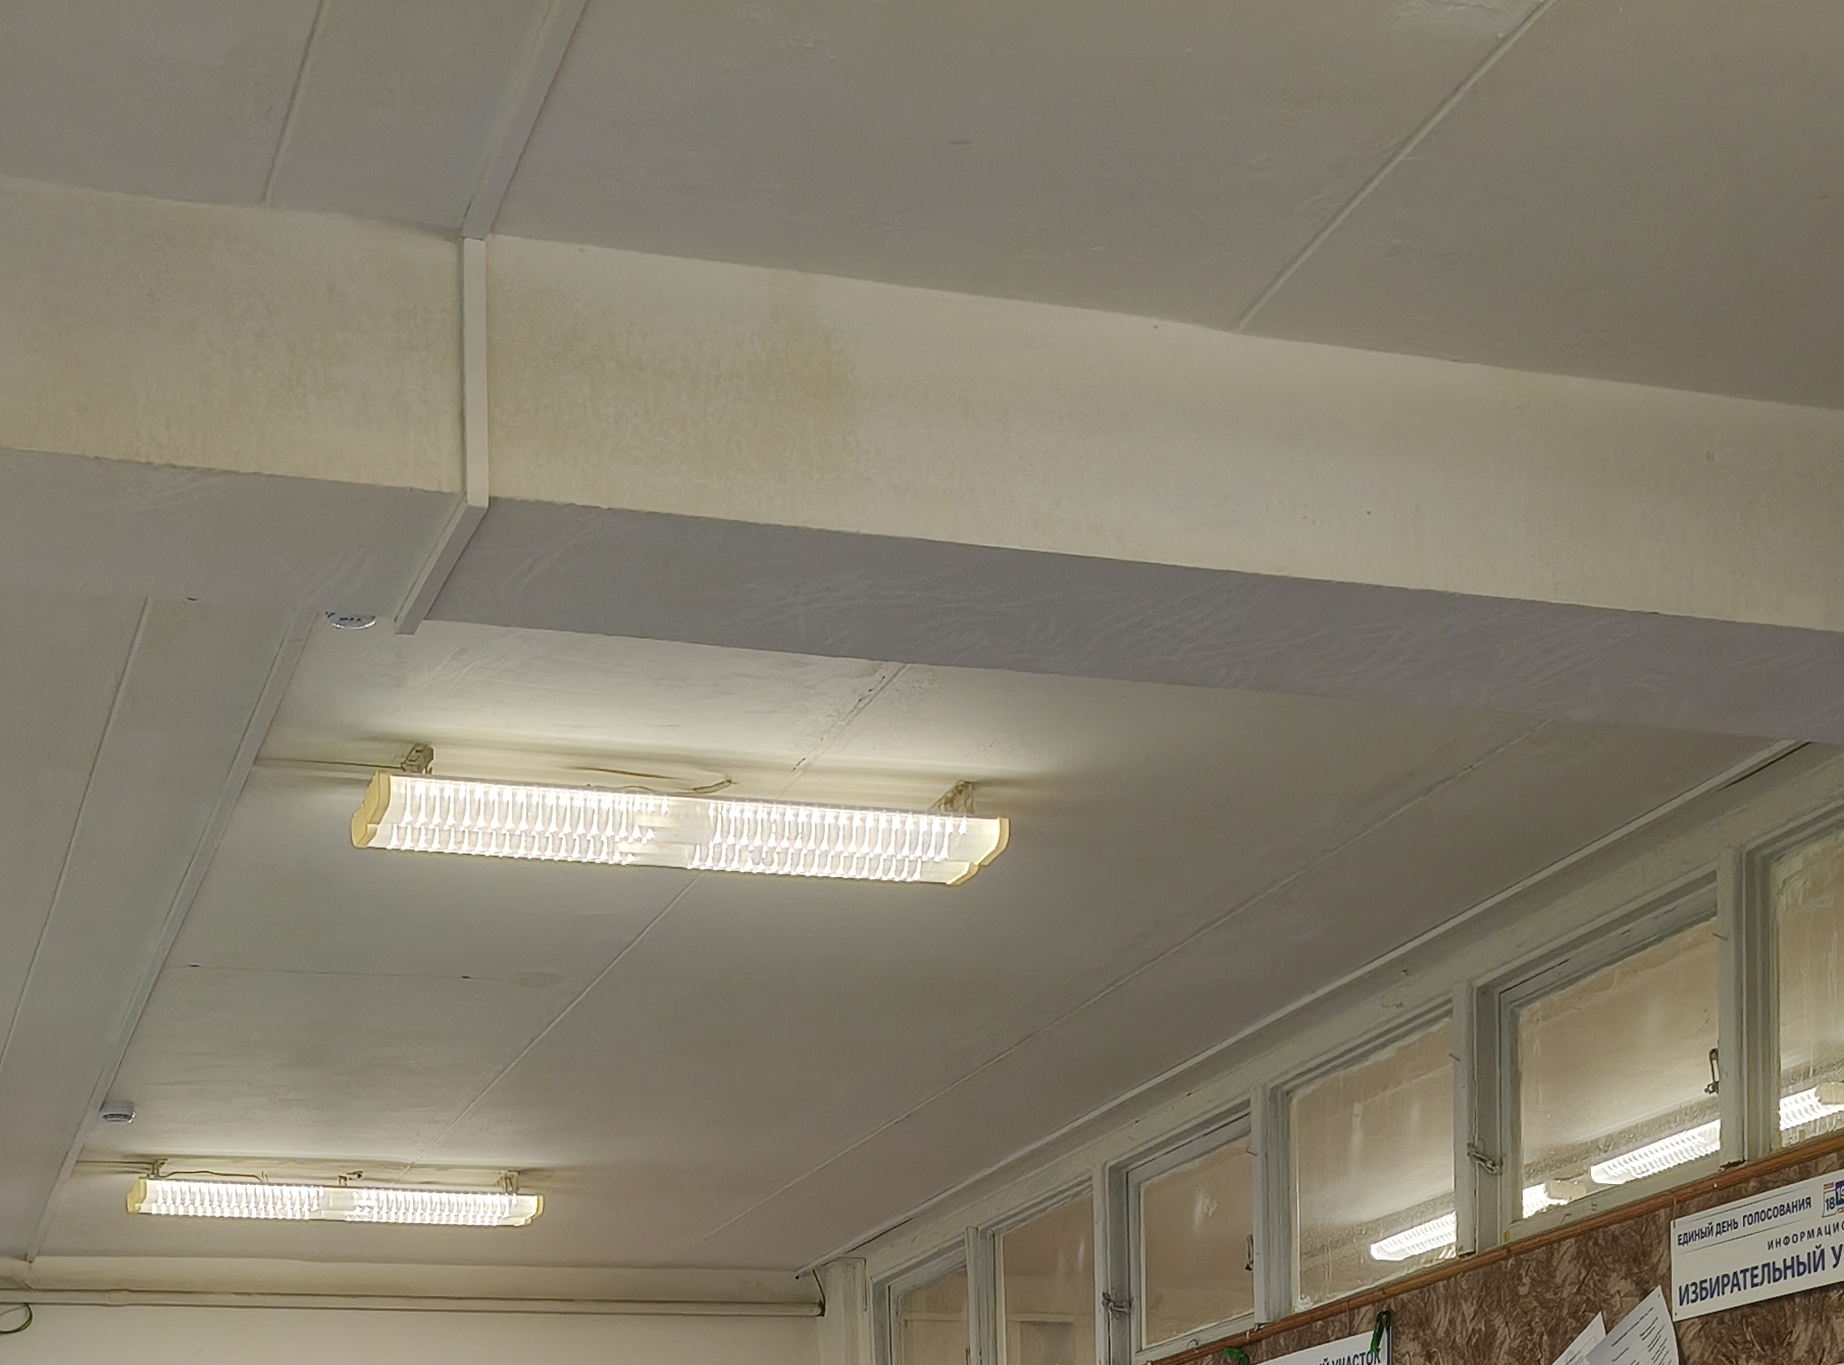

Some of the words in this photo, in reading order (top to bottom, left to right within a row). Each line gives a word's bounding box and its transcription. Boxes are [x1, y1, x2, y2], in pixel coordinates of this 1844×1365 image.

[1677, 1222, 1714, 1247] ЕДИНЫЙ
[1715, 1218, 1739, 1239] ДЕНЬ
[1742, 1196, 1812, 1228] ГОЛОСОВАНИЯ
[1825, 1197, 1836, 1211] 18
[1678, 1243, 1825, 1306] ИЗБИРАТЕЛЬНЫЙ
